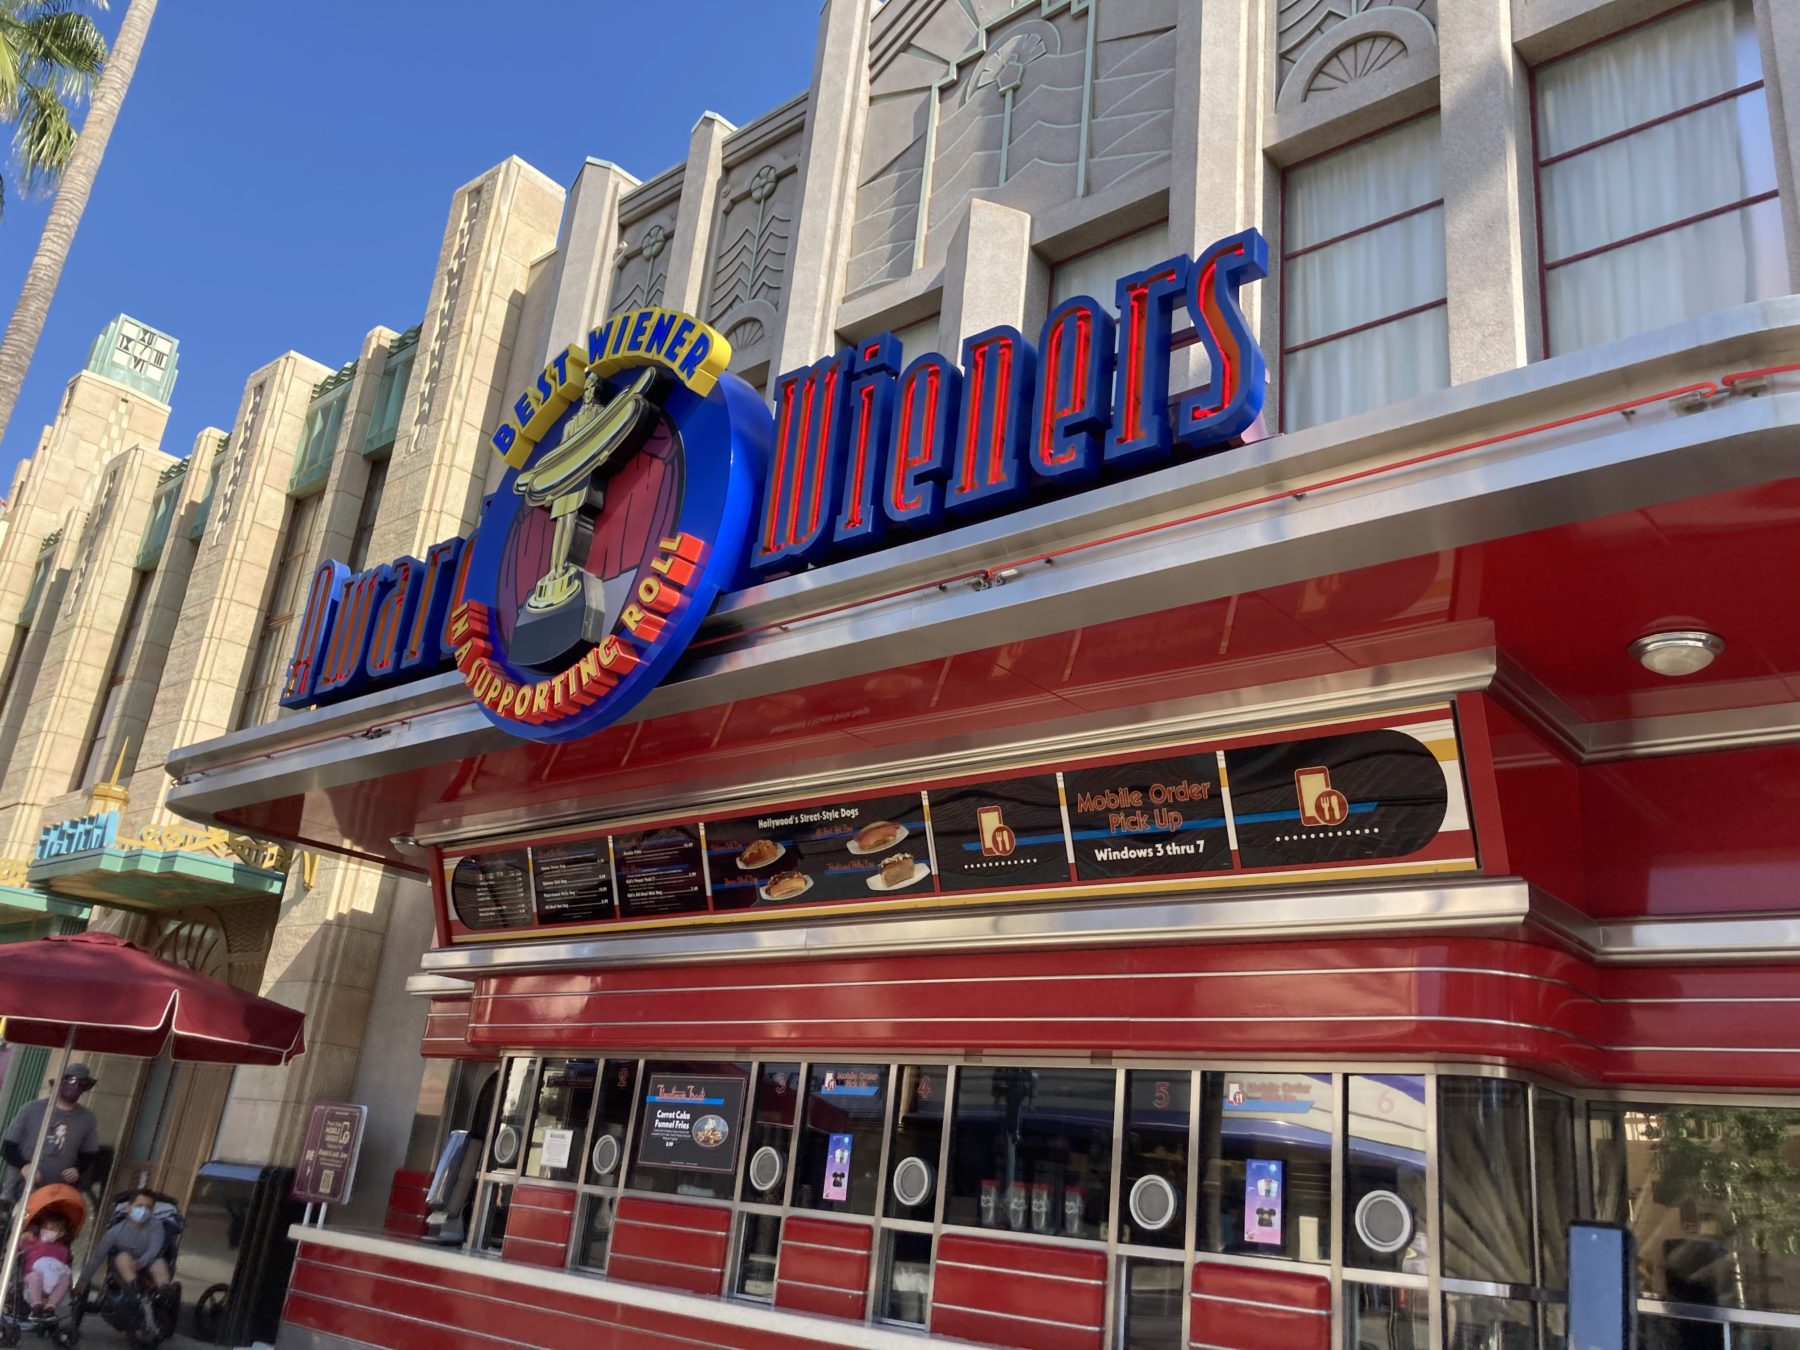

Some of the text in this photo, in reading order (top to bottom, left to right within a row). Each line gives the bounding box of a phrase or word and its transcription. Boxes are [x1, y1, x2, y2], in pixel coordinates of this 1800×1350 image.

[493, 310, 711, 460] BEST WIENER
[750, 228, 1268, 569] Wieners
[450, 533, 683, 717] IN A SUPPORTING ROLL
[1077, 780, 1211, 813] Mobile Order
[758, 808, 859, 829] Hollywood's Street-Style Dogs
[1109, 808, 1184, 833] Pick Up
[1095, 840, 1206, 862] Windows 3 thru 7
[917, 1076, 931, 1099] 4
[1153, 1081, 1169, 1109] 5
[656, 1109, 691, 1120] Carrot Cake
[1378, 1089, 1395, 1115] 6
[654, 1119, 690, 1130] Funnel Fries
